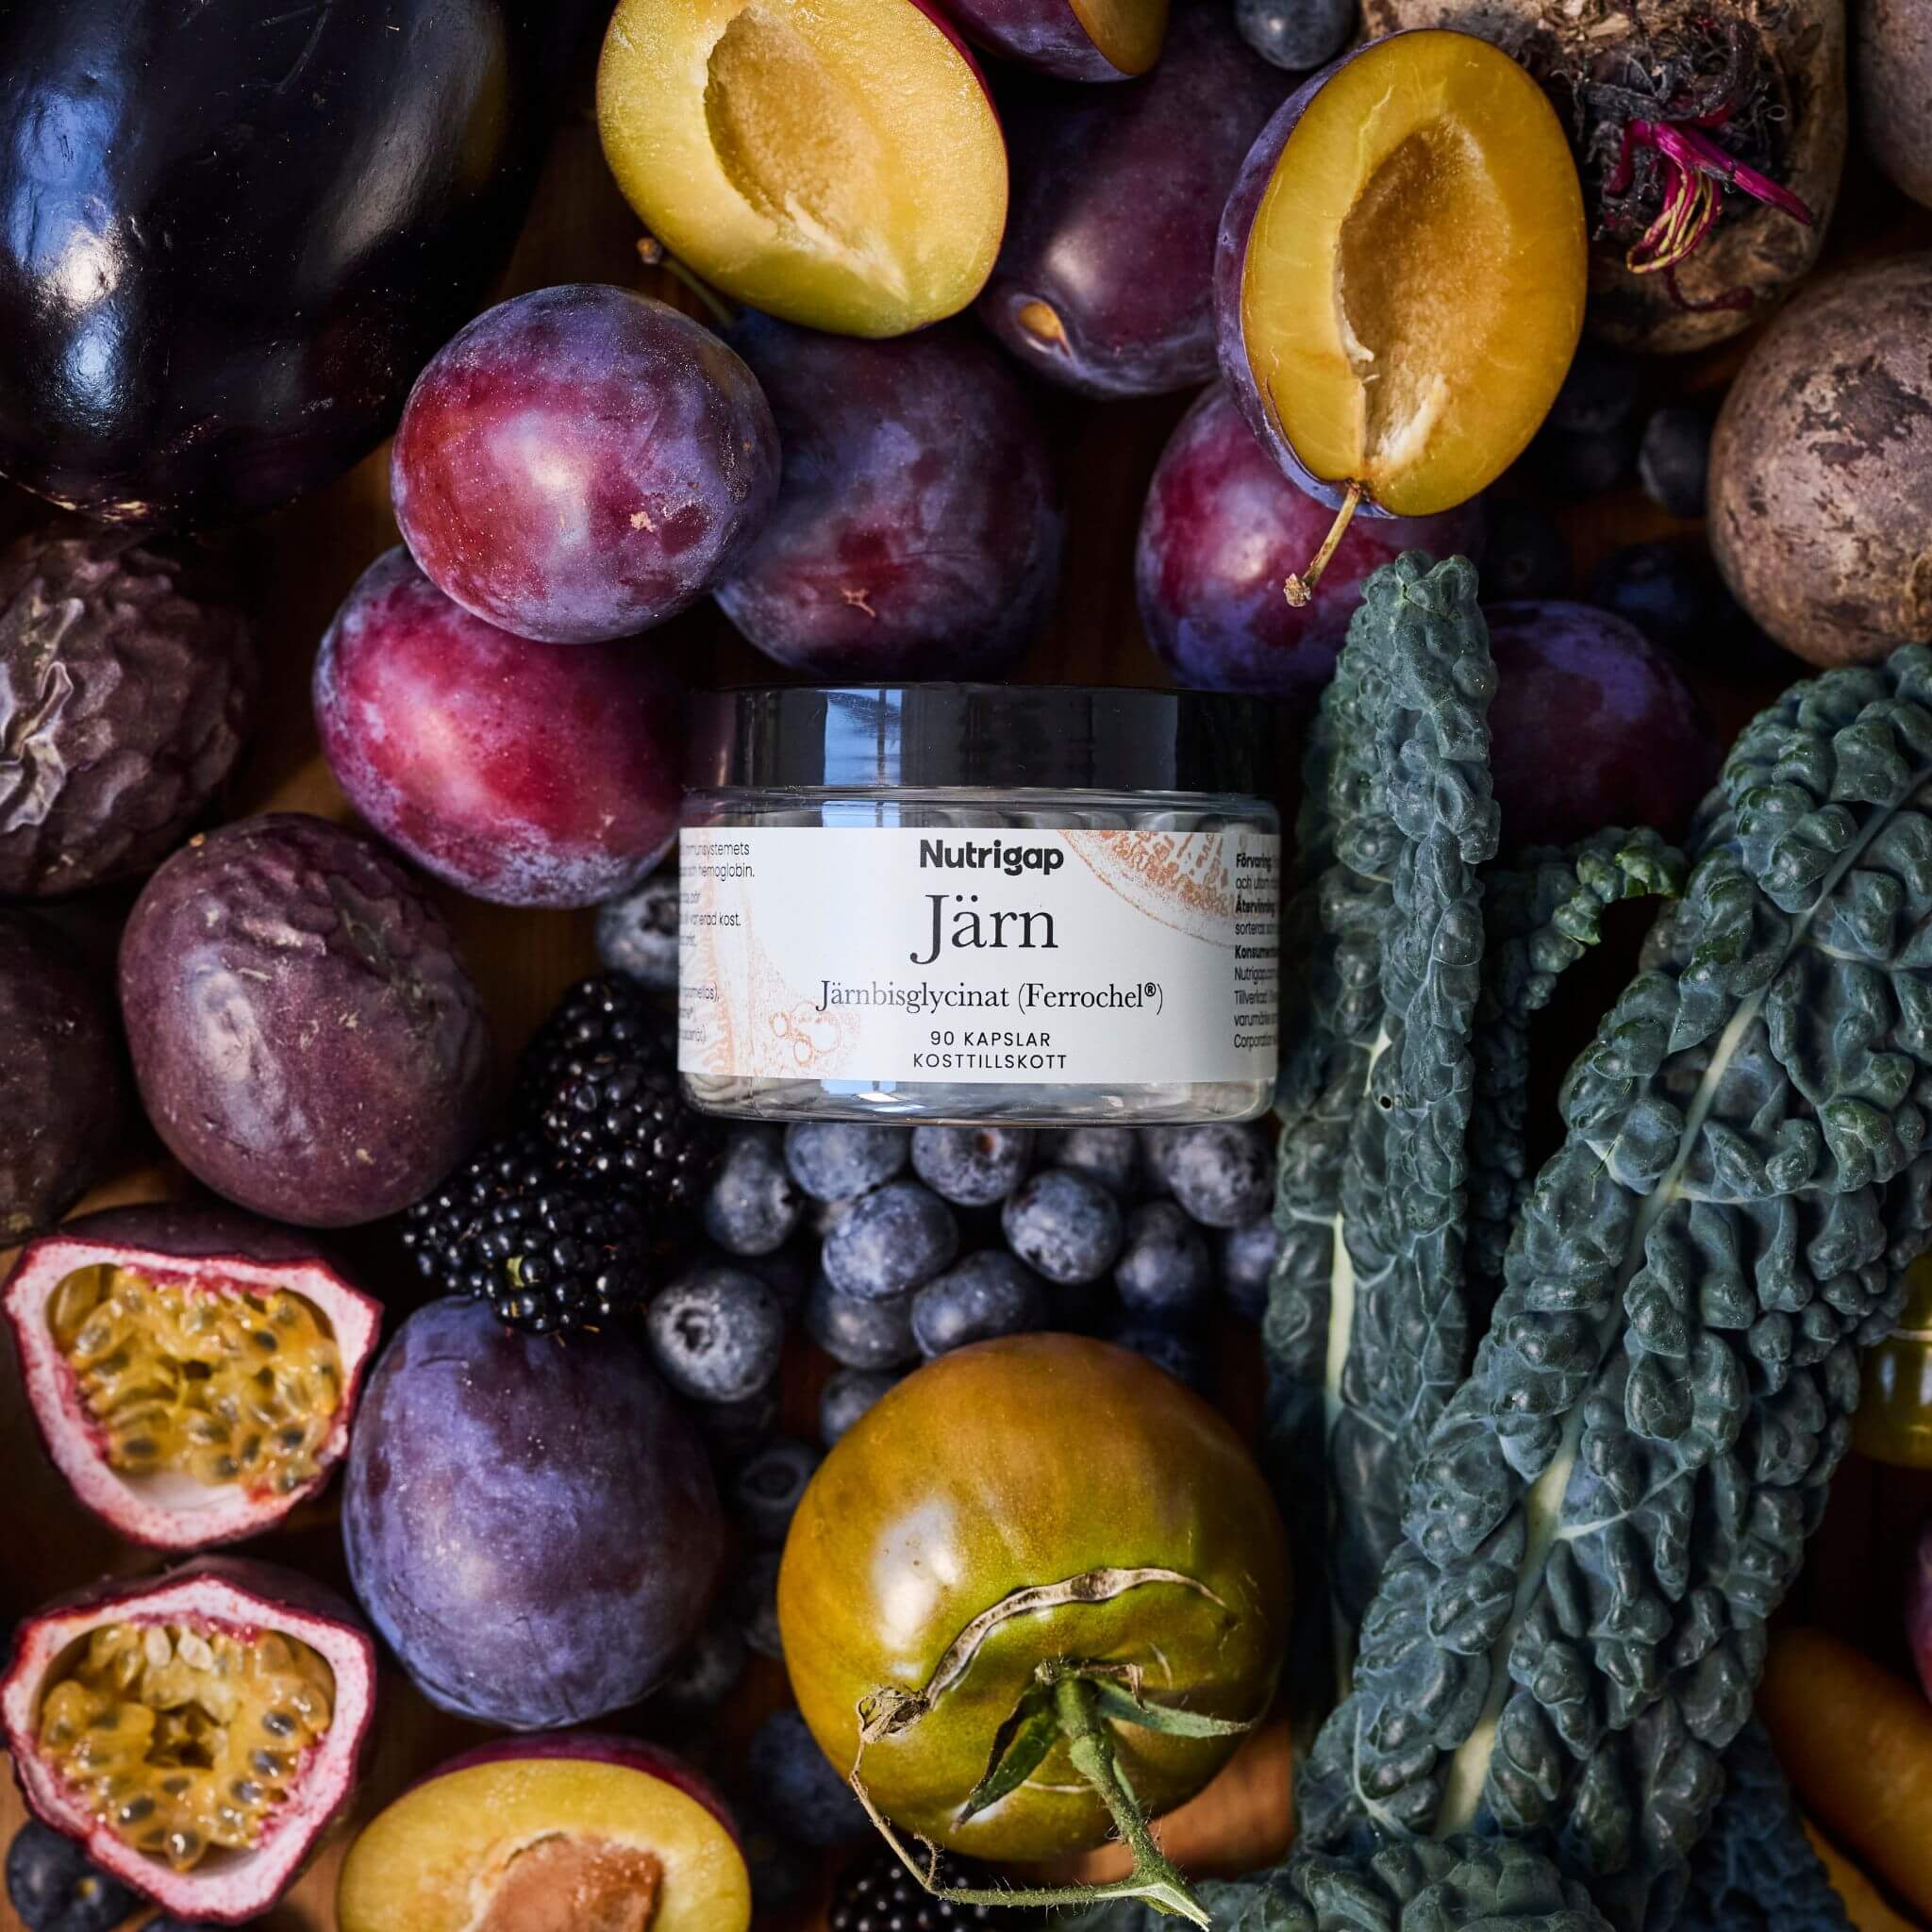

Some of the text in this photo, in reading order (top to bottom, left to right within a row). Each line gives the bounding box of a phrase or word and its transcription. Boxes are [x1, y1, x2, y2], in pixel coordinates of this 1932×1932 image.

[920, 839, 1064, 875] Nutrigap
[698, 862, 755, 881] hemoglobin.
[1236, 875, 1252, 890] och
[719, 911, 741, 926] kost.
[909, 893, 1059, 964] Järn
[815, 979, 1164, 1015] Järnbisglycinat (Ferrochel®)
[929, 1030, 1051, 1047] 90 KAPSLAR
[912, 1053, 1067, 1070] KOSTTILLSKOTT
